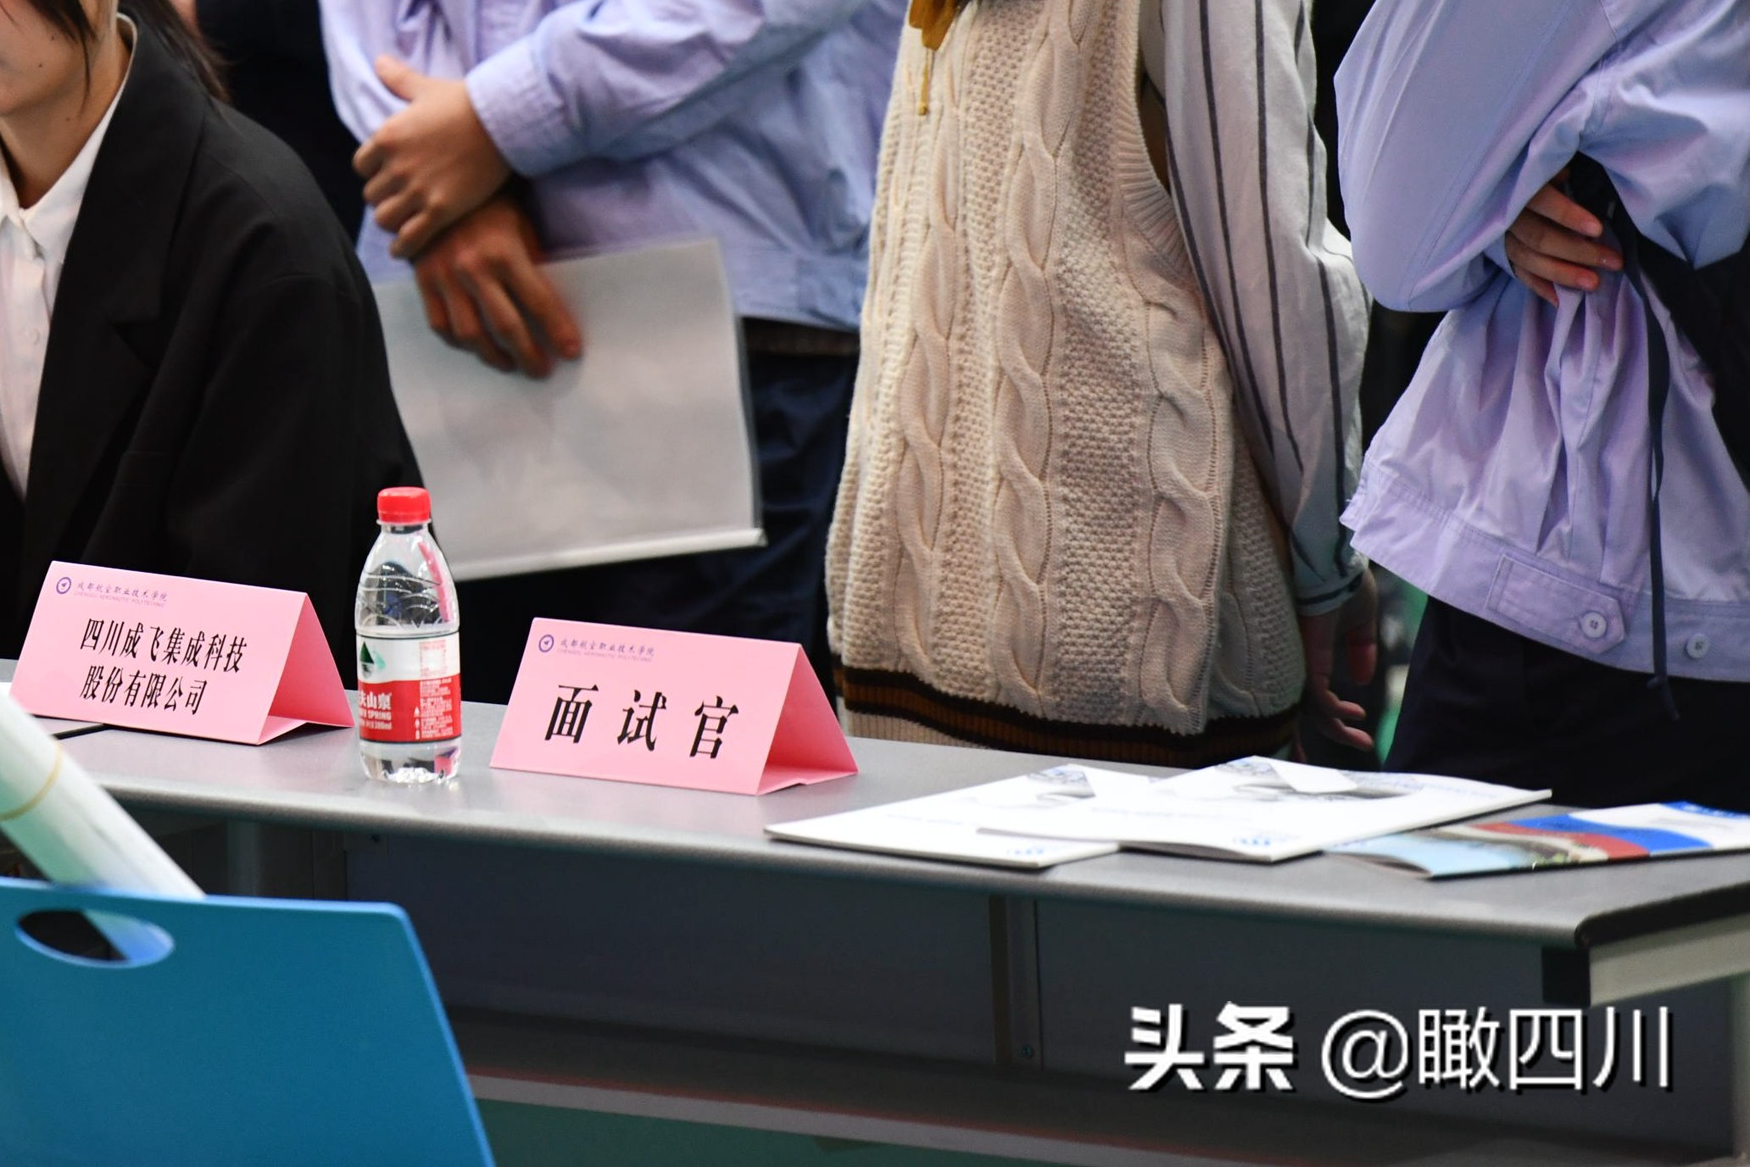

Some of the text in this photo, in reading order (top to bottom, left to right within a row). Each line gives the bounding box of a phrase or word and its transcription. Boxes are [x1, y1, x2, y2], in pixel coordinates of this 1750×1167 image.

[80, 618, 247, 673] 四川成飞集成科技
[79, 665, 207, 715] 股份有限公司
[544, 684, 739, 759] 面试官
